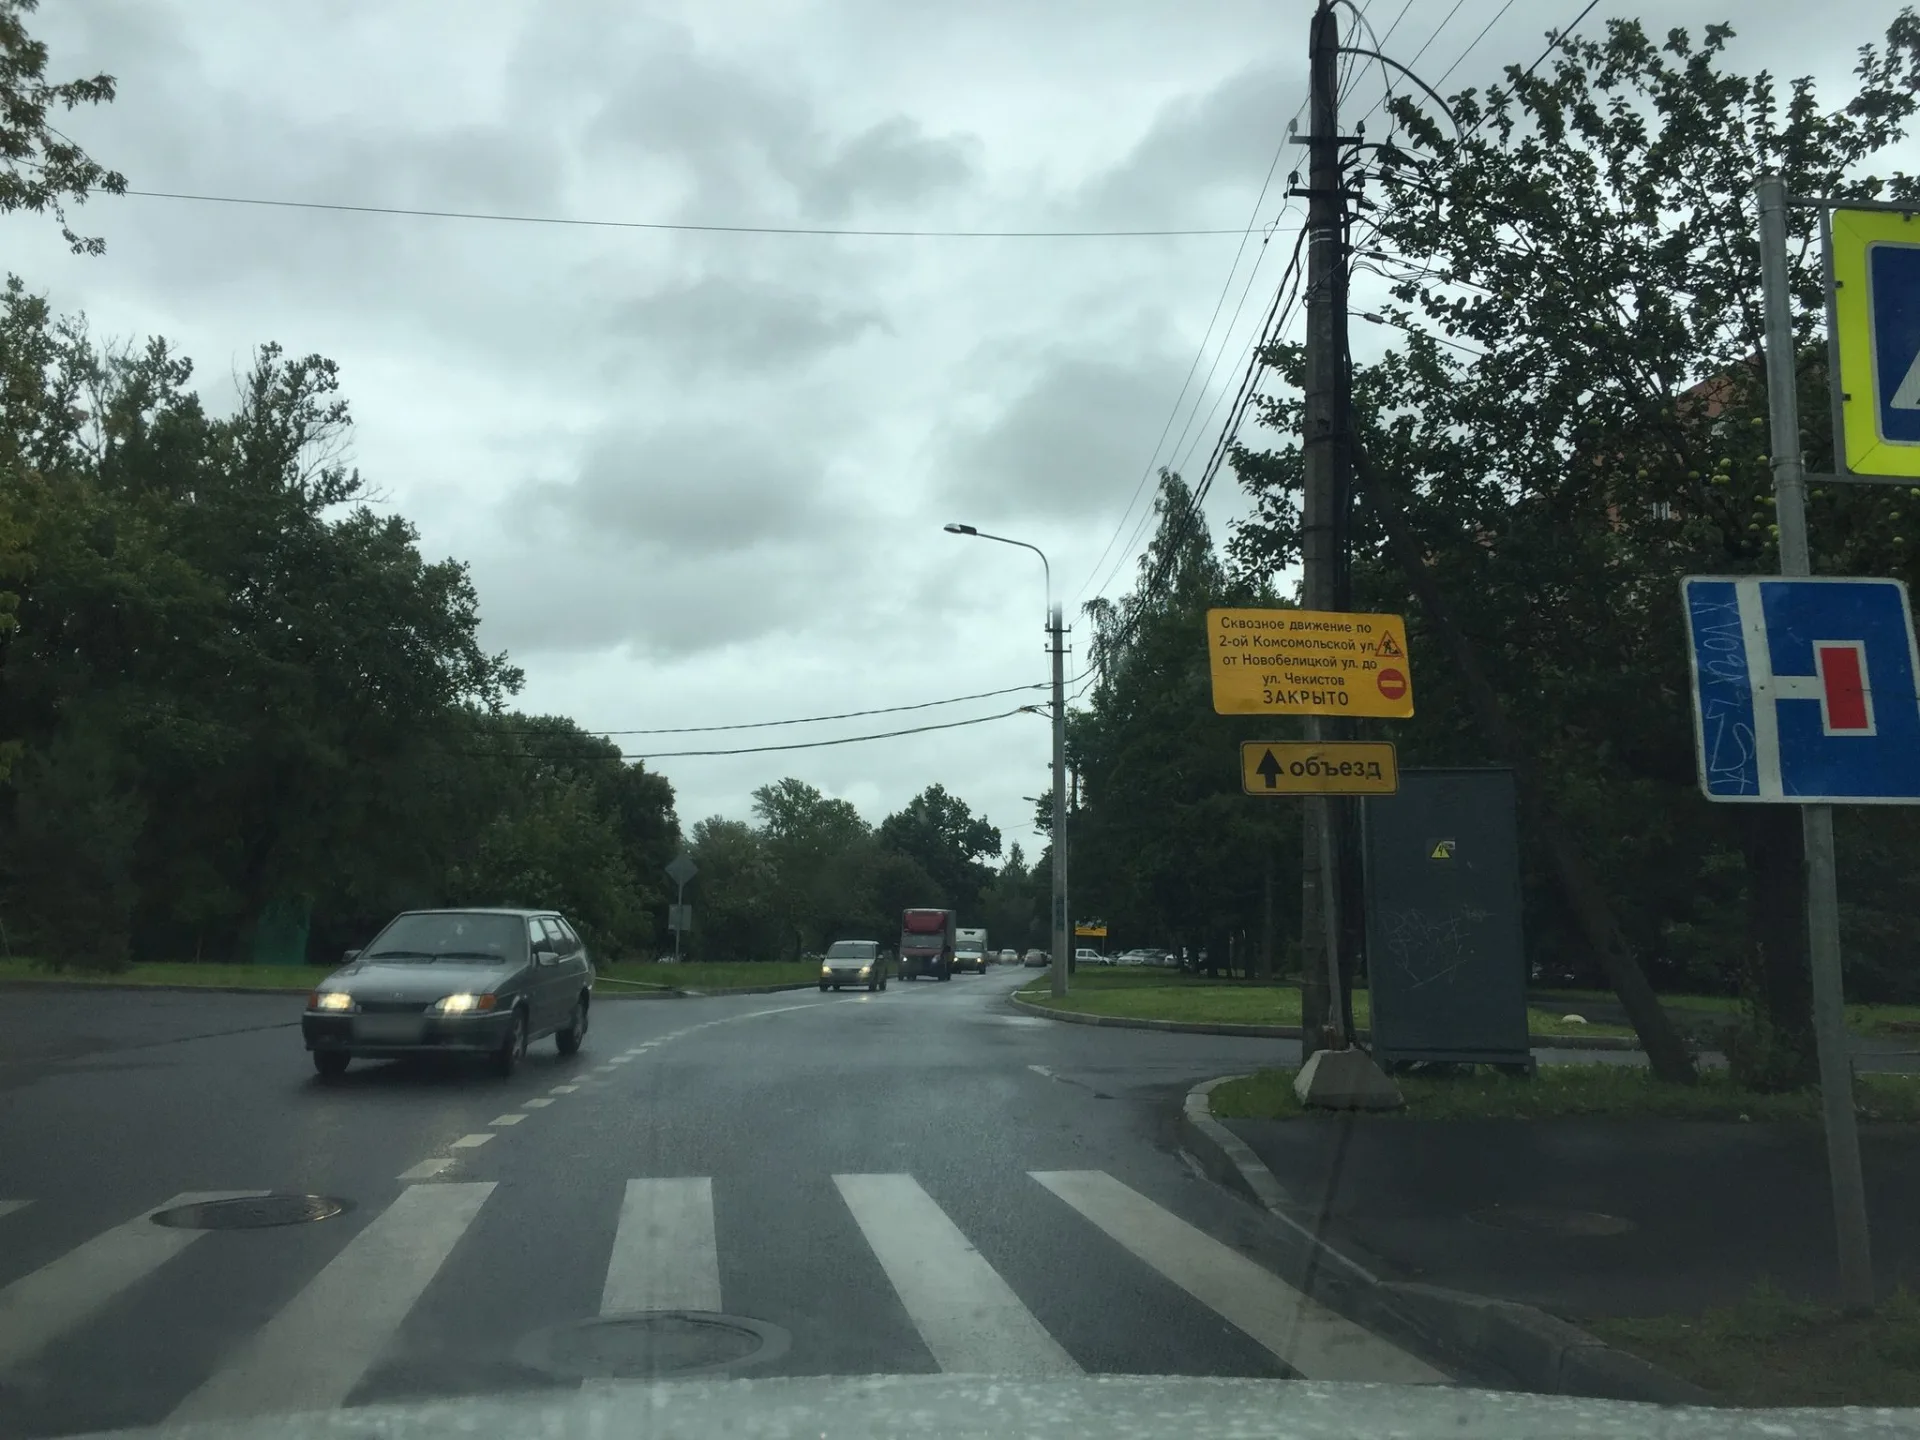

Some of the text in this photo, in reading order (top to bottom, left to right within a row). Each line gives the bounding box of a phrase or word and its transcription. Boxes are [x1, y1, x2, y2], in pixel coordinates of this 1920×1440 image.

[1221, 617, 1372, 633] Сквозное движение по
[1220, 635, 1248, 647] 2-ой
[1253, 636, 1356, 650] Комсомольской
[1223, 654, 1377, 671] от Новобелицкой ул. до
[1262, 674, 1345, 686] ул. Чекистов
[1264, 690, 1349, 706] ЗАКРЫТО
[1290, 756, 1382, 780] объезд
